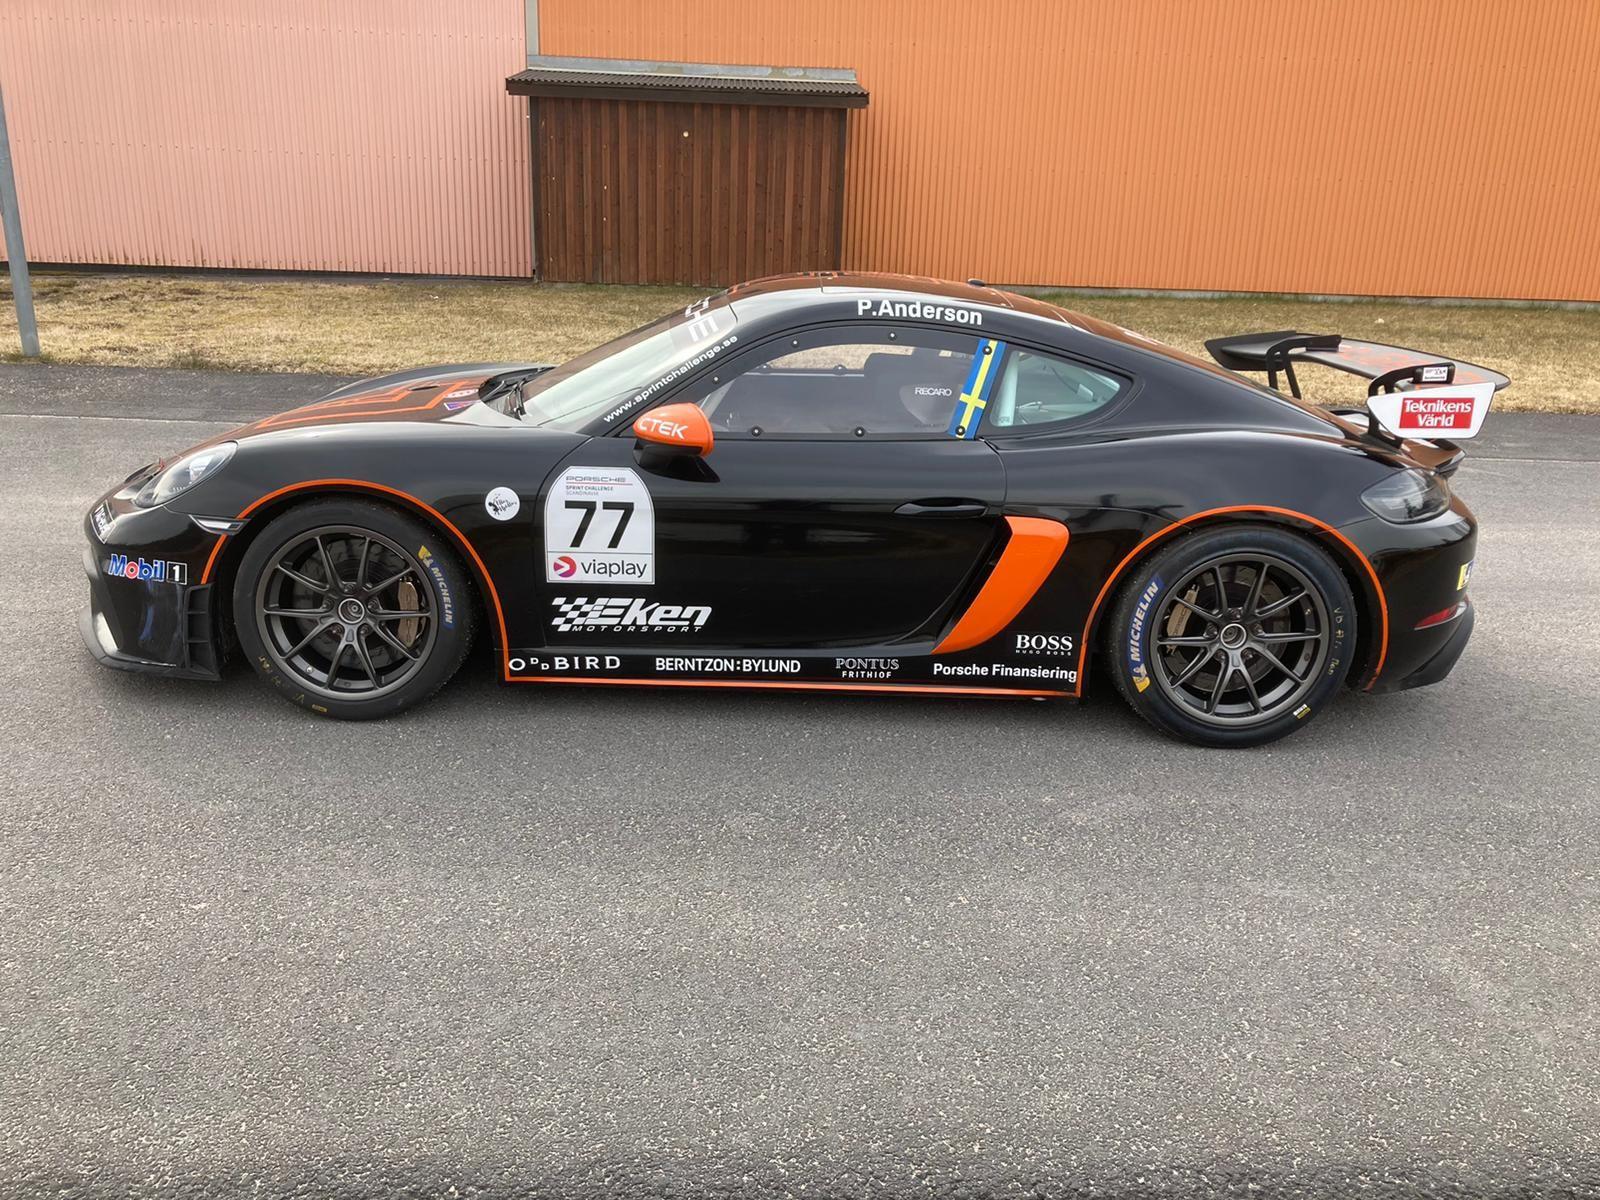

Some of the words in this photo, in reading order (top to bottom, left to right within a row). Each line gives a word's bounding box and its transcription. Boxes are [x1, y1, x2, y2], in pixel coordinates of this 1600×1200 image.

[857, 299, 983, 326] P.Anderson
[603, 335, 738, 423] www.sprintchallenge.se
[914, 386, 952, 397] RECARO
[1404, 400, 1472, 413] Teknikens
[637, 417, 688, 440] CTEK
[1417, 413, 1455, 427] Värld
[564, 500, 635, 549] 77
[108, 553, 165, 583] Mobil
[581, 559, 648, 578] viaplay
[430, 566, 454, 624] MICHELIN
[584, 598, 713, 626] Eken
[1130, 581, 1158, 661] MICHELIN
[571, 625, 702, 633] MOTORSPORT
[1015, 634, 1074, 651] BOSS
[835, 657, 900, 670] PONTUS
[933, 662, 989, 676] Porsche
[992, 664, 1078, 683] Finansiering
[841, 670, 892, 679] FRITHIOF
